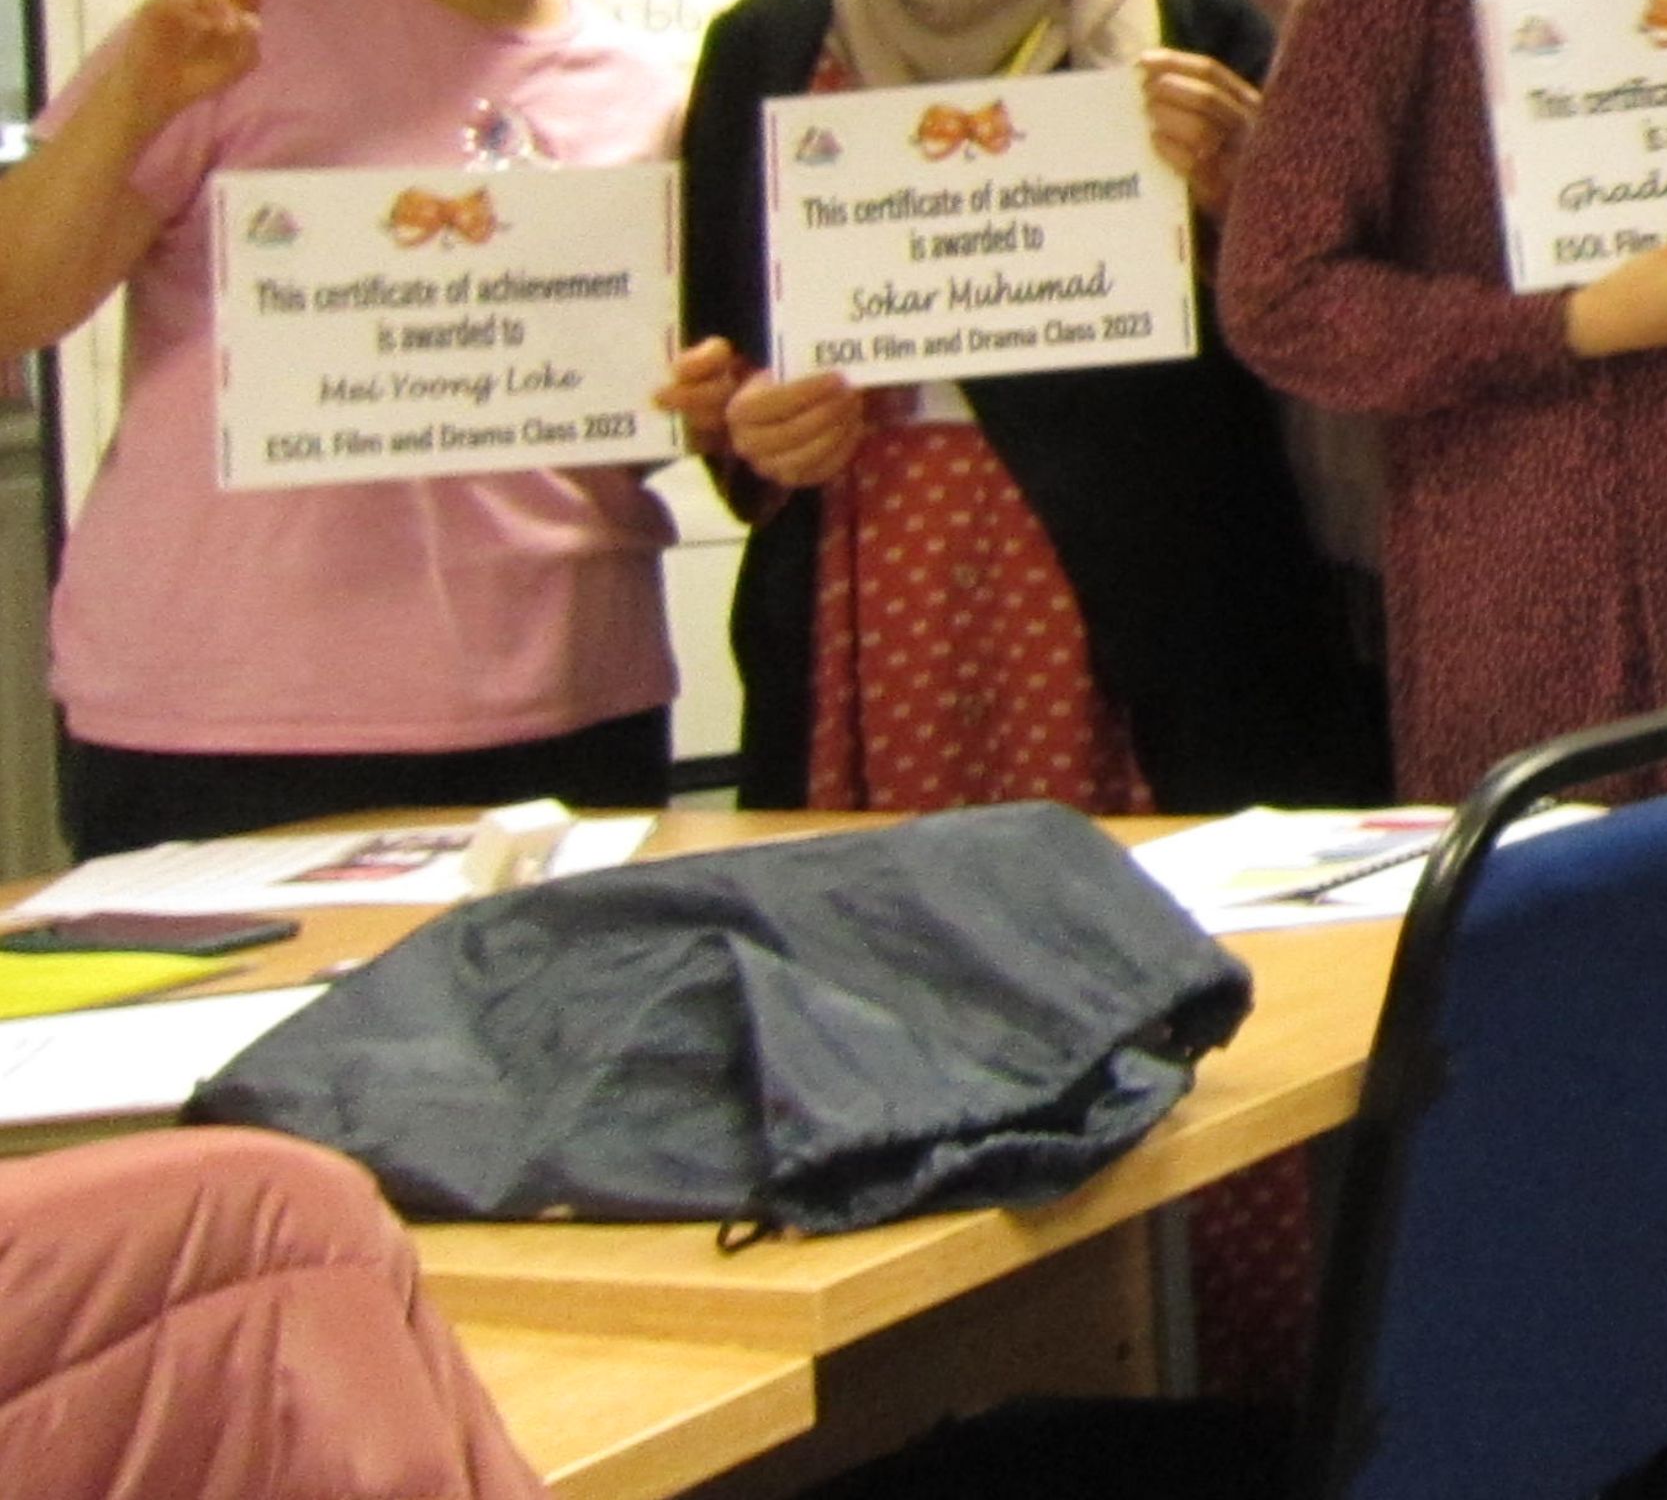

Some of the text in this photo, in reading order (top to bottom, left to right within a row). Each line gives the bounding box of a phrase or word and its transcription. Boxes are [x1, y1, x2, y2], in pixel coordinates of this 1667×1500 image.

[1527, 88, 1578, 121] This
[1643, 117, 1662, 153] is
[803, 173, 1142, 229] This certificate of achievement
[909, 221, 1045, 262] is awarded to
[1554, 232, 1612, 266] ESOL
[257, 269, 631, 314] This certificate of achievement
[849, 260, 1115, 324] Sokar Muhumad
[376, 315, 526, 353] is awarded to
[815, 311, 1154, 368] ESOL Film and Drama Class 2023
[507, 360, 583, 396] Loke
[265, 409, 638, 465] ESOL Film and Drama Class 2023
